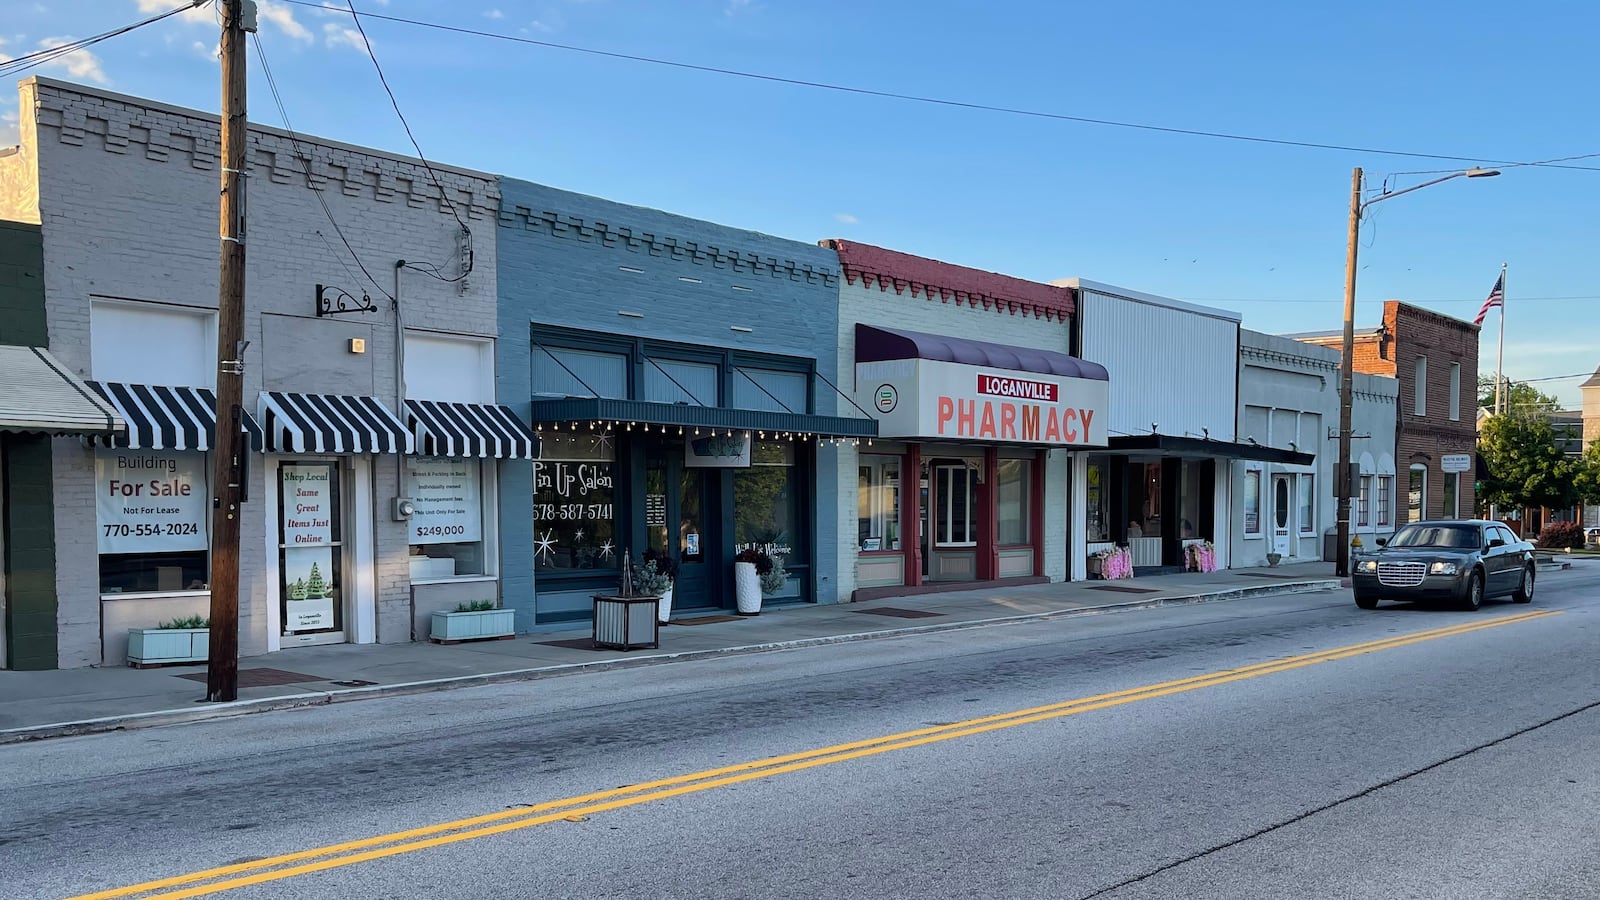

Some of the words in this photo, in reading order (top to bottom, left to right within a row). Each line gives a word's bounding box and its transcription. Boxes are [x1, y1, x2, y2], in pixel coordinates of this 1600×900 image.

[985, 376, 1051, 400] LOGANVILLE
[938, 396, 1094, 443] PHARMACY
[118, 456, 176, 473] Building
[284, 471, 305, 483] Shop
[306, 471, 328, 481] Local
[532, 461, 553, 495] Pin
[554, 463, 575, 497] Up
[578, 464, 614, 496] Salon
[109, 479, 144, 497] For
[150, 479, 191, 497] Sale
[296, 487, 319, 497] Same
[123, 506, 139, 515] Not
[141, 506, 155, 515] For
[156, 506, 180, 514] Lease
[296, 503, 319, 514] Great
[287, 518, 310, 528] Items
[311, 518, 329, 527] Just
[103, 522, 198, 537] 770-554-2024
[416, 525, 465, 537] $249,000
[295, 534, 322, 543] Online
